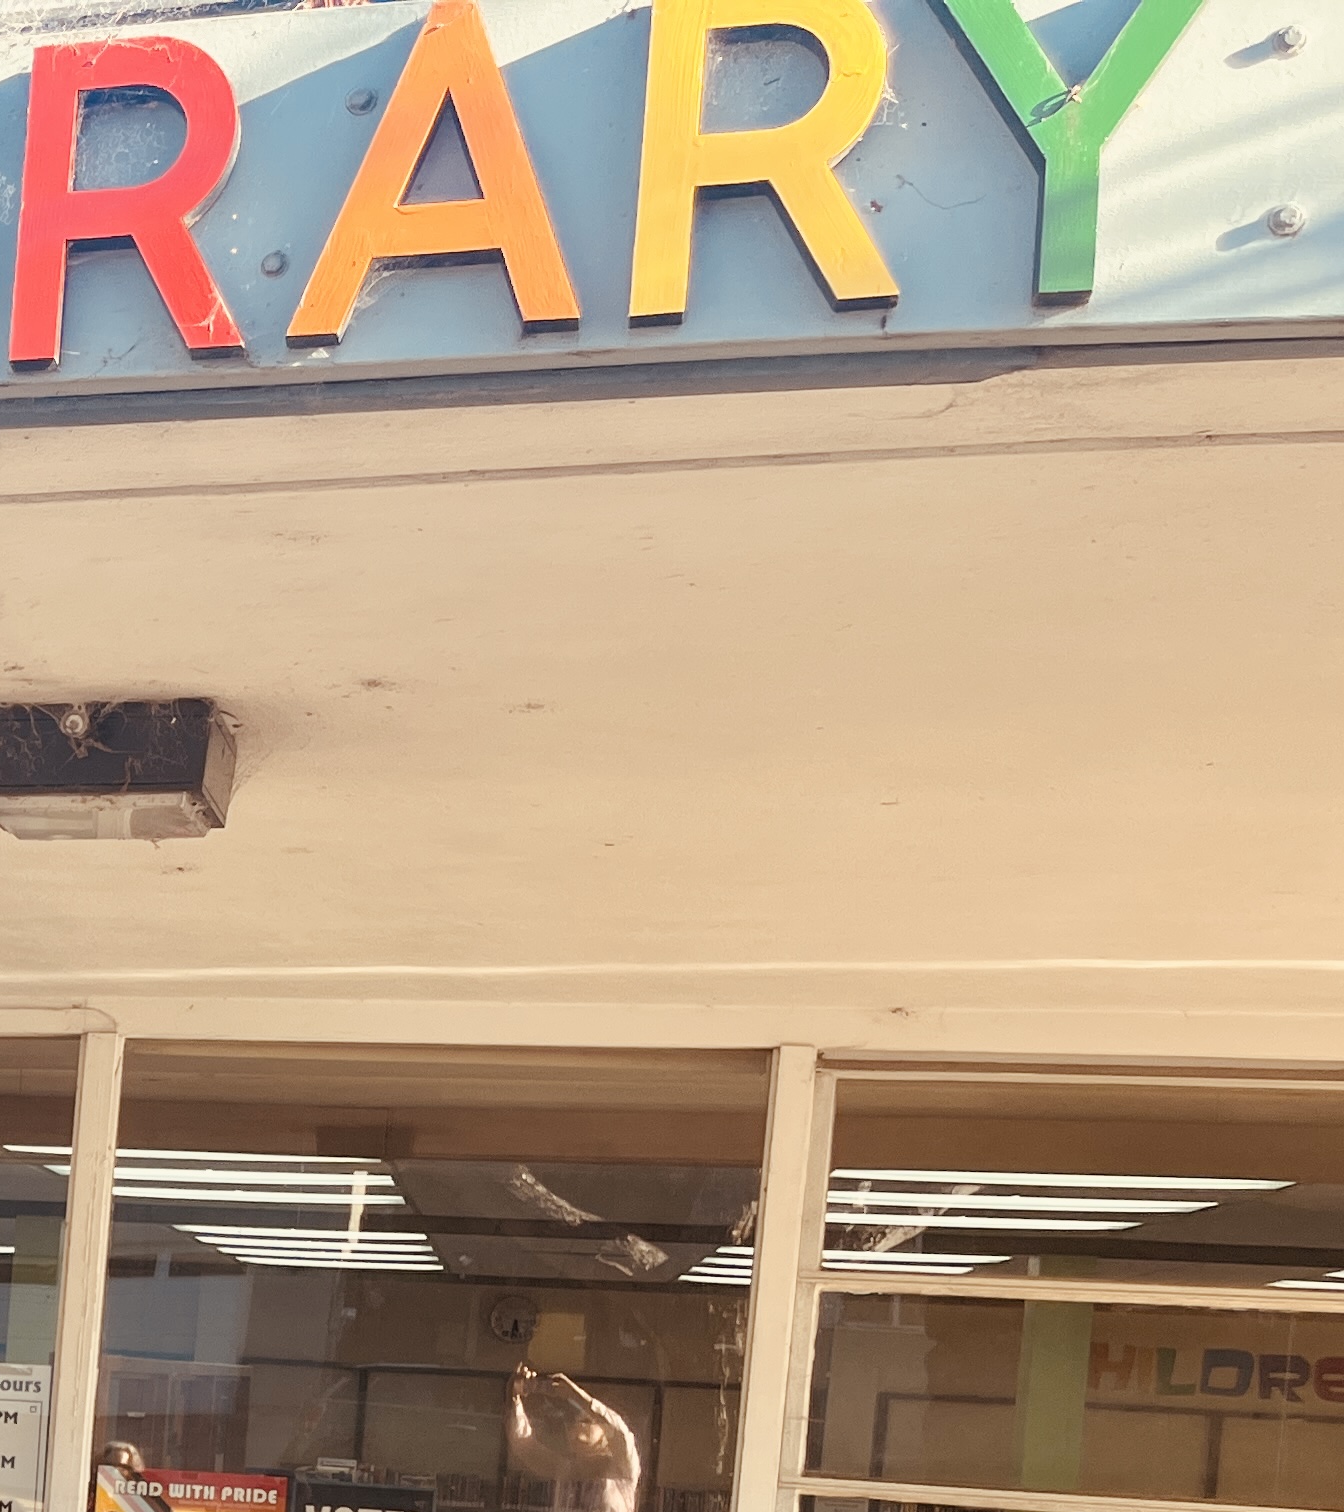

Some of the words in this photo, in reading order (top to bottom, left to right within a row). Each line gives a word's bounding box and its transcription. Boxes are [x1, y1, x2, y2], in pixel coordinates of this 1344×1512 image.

[1087, 1341, 1344, 1402] HILDRE
[114, 1480, 163, 1497] READ
[168, 1483, 215, 1499] WITH
[221, 1486, 278, 1504] PRIDE
